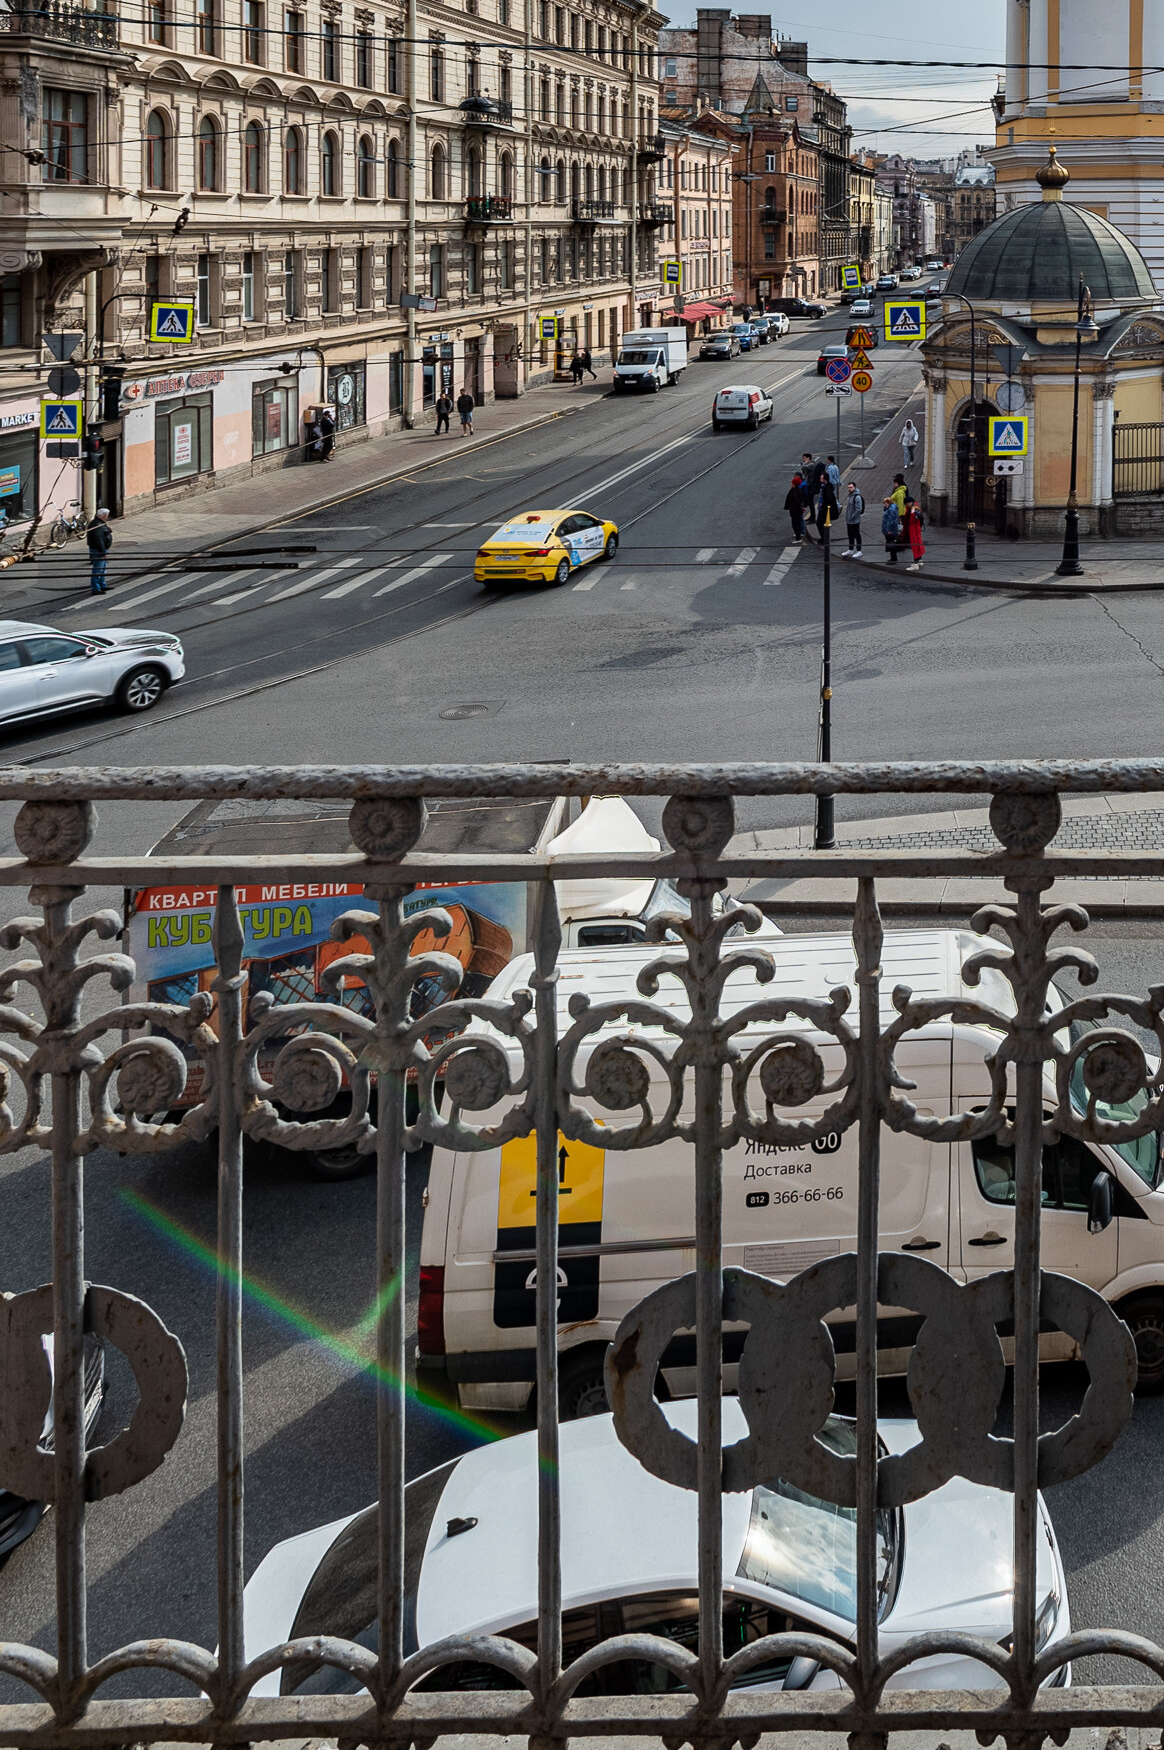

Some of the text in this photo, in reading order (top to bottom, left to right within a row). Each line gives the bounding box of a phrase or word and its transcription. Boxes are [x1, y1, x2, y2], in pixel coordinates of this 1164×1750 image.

[148, 377, 186, 395] АПТЕКА
[856, 377, 867, 386] 40
[1, 411, 37, 428] MARKET
[149, 883, 348, 909] КВАРТЛ МЕБЕЛИ
[147, 904, 312, 948] КУБТУРА
[744, 1163, 812, 1181] Доставка
[750, 1187, 844, 1205] 812 366-66-66
